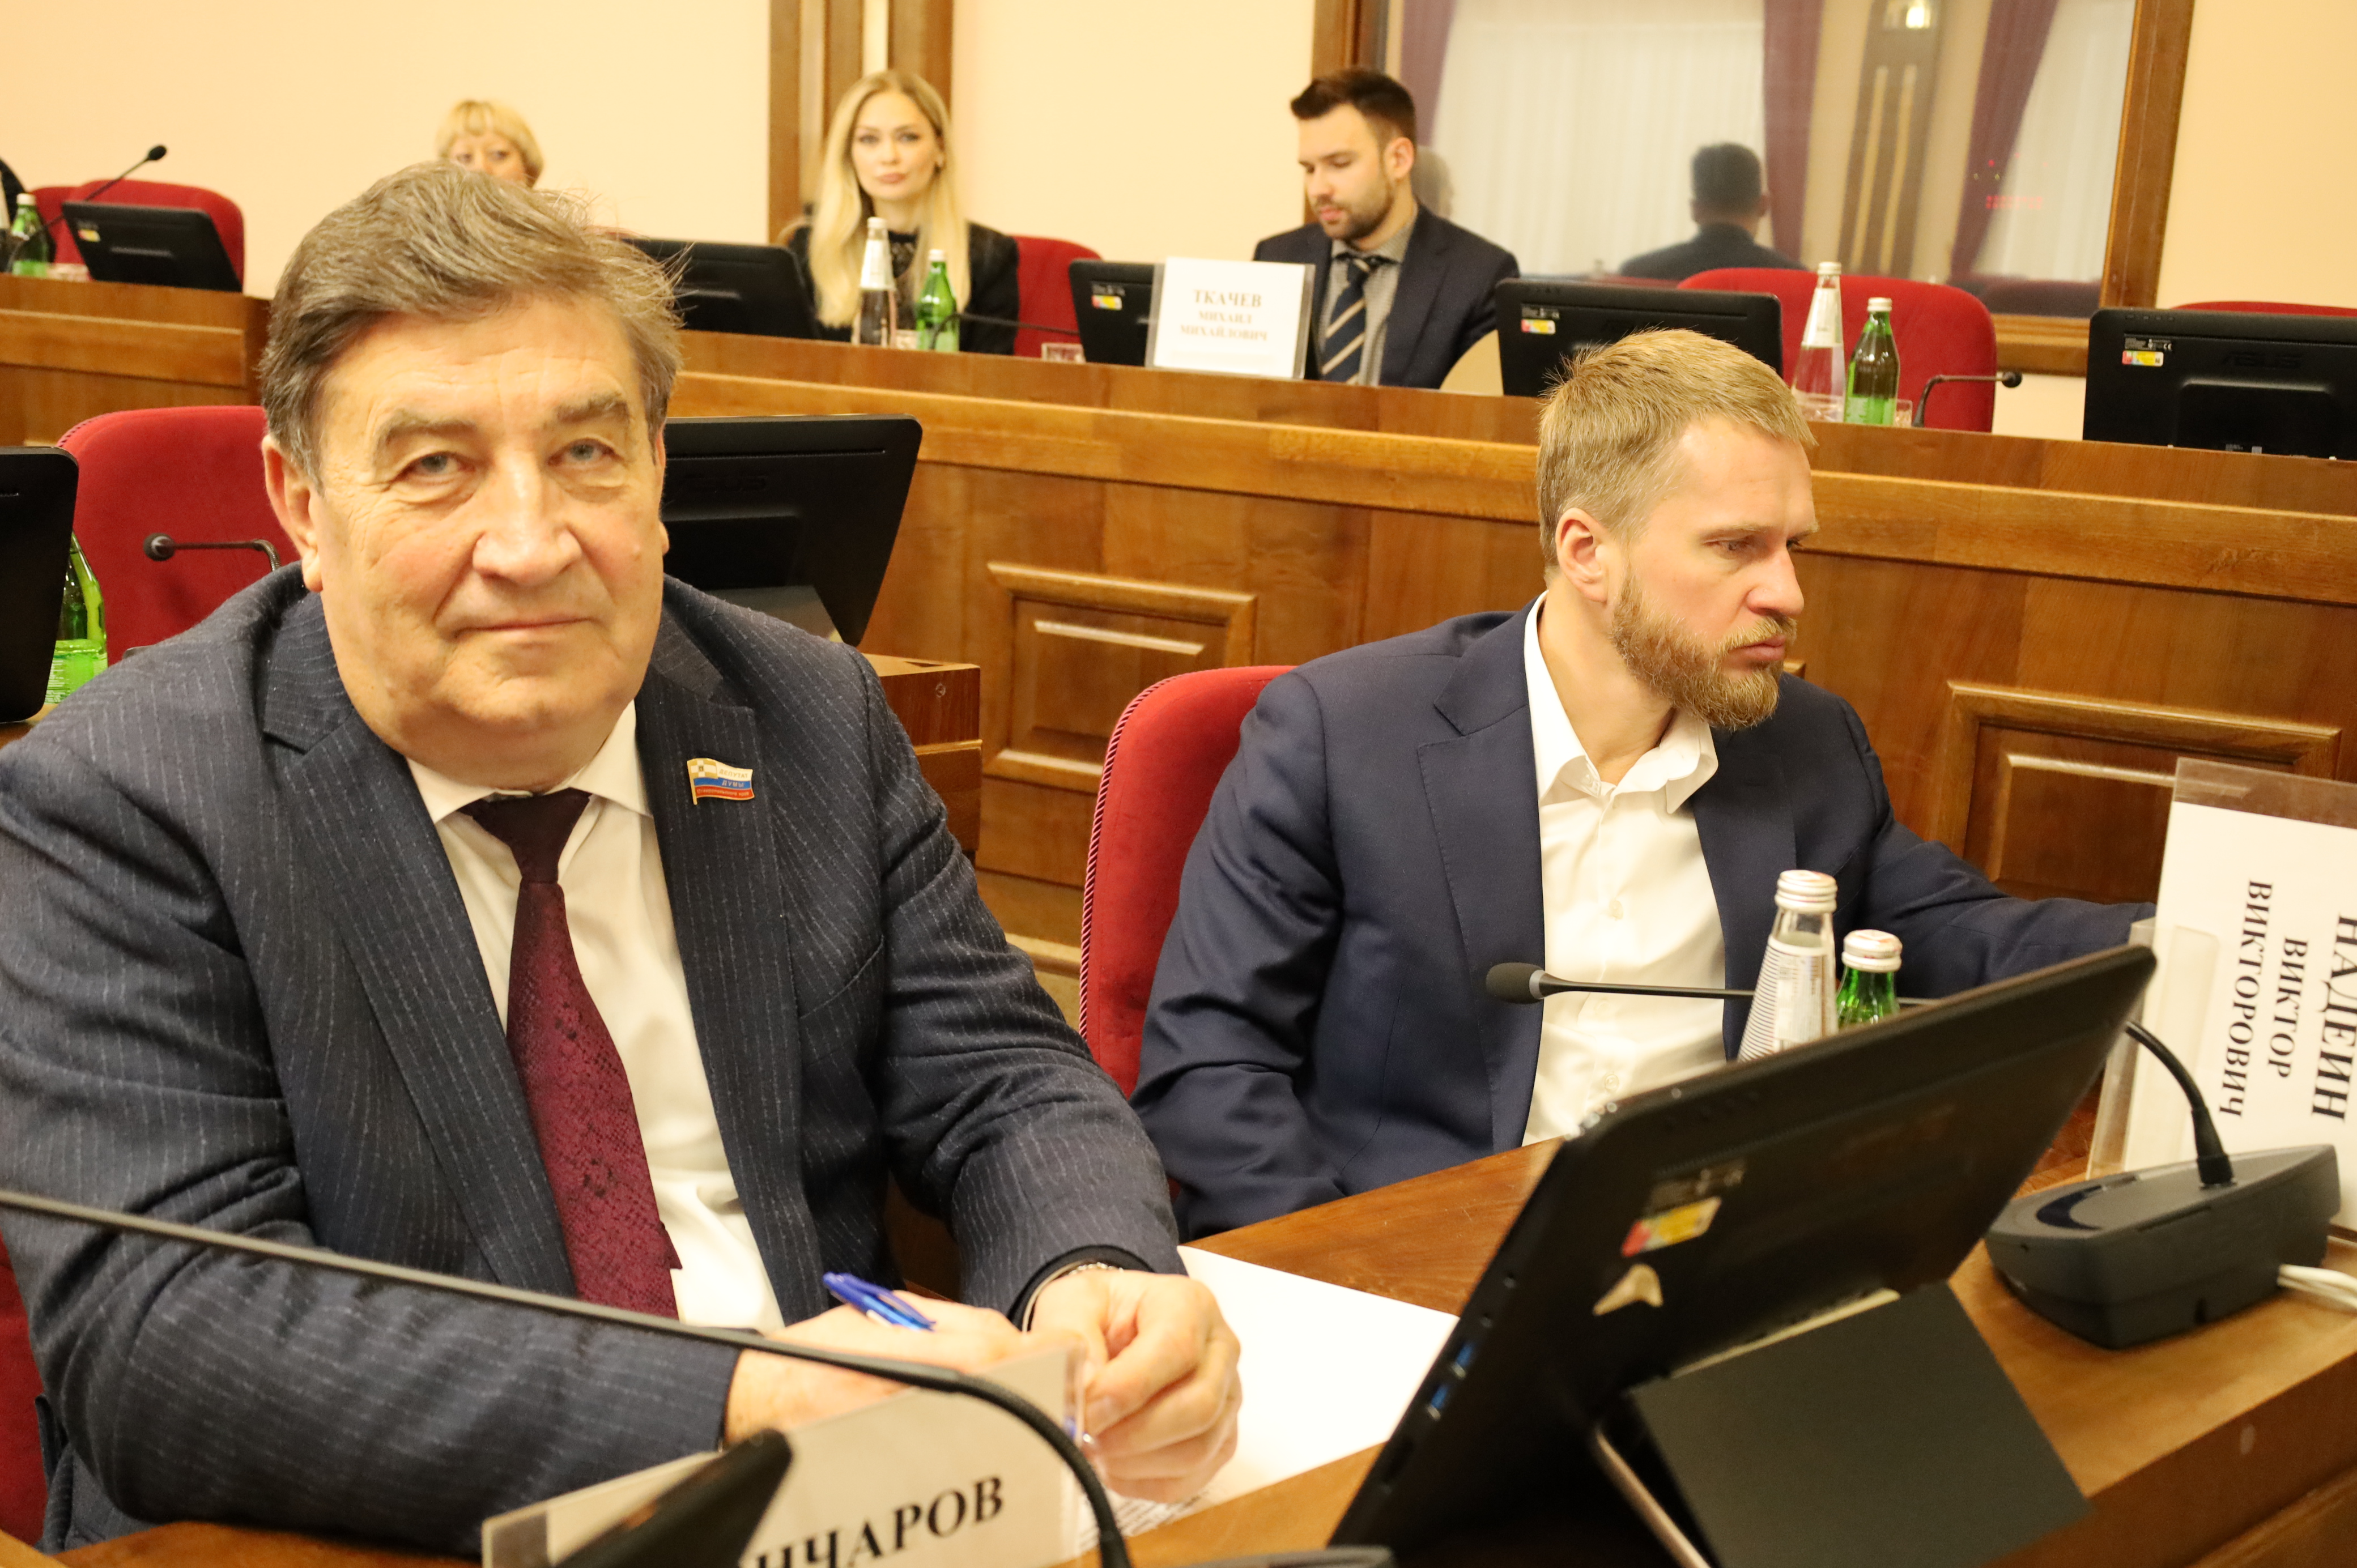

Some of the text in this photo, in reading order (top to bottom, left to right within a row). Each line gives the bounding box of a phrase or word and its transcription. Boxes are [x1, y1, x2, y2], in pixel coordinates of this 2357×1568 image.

[1193, 289, 1262, 308] ТКАЧЕВ
[1198, 310, 1252, 325] МИХАИЛ
[1180, 324, 1267, 342] МИХАЙЛОВИЧ
[719, 769, 748, 778] ДЕПУТАТ
[2219, 879, 2274, 1119] ВИКТОРОВИЧ
[2267, 936, 2308, 1079] ВИКТОР
